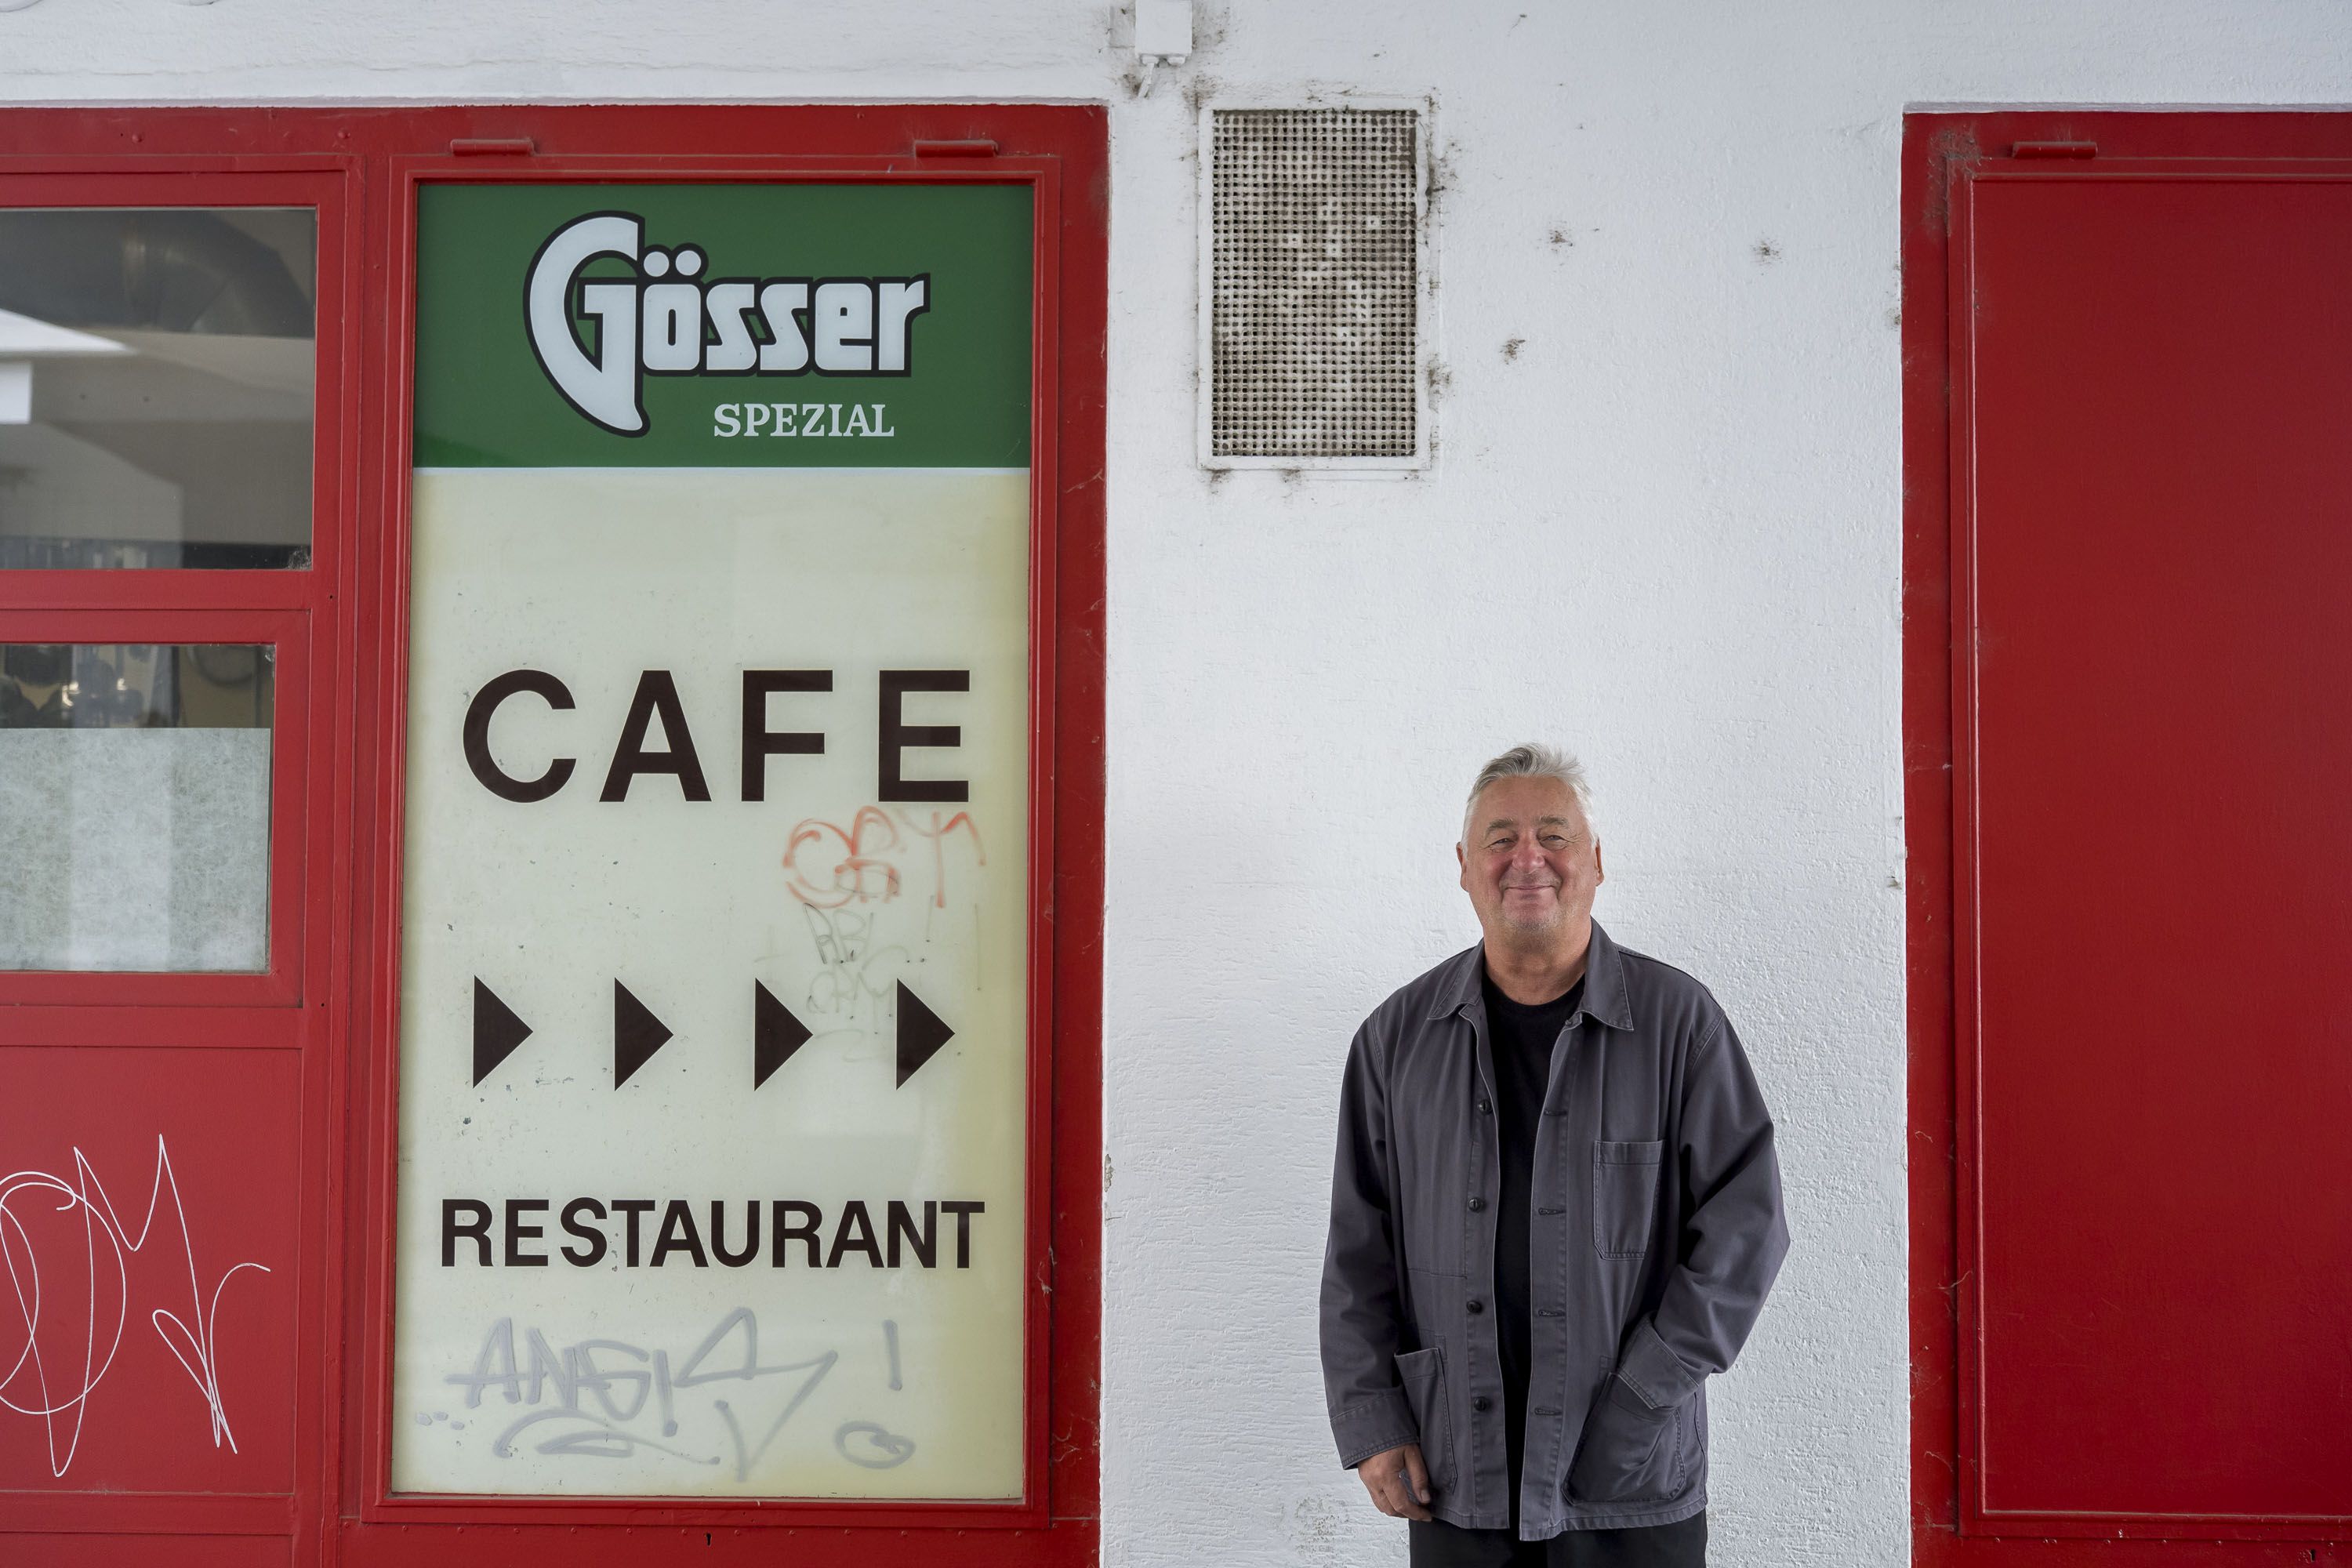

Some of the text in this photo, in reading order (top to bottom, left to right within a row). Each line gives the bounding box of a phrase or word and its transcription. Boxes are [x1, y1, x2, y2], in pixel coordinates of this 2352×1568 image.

[523, 210, 931, 438] Gösser
[713, 402, 895, 437] SPEZIAL
[463, 669, 971, 803] CAFE
[441, 1196, 985, 1269] RESTAURANT
